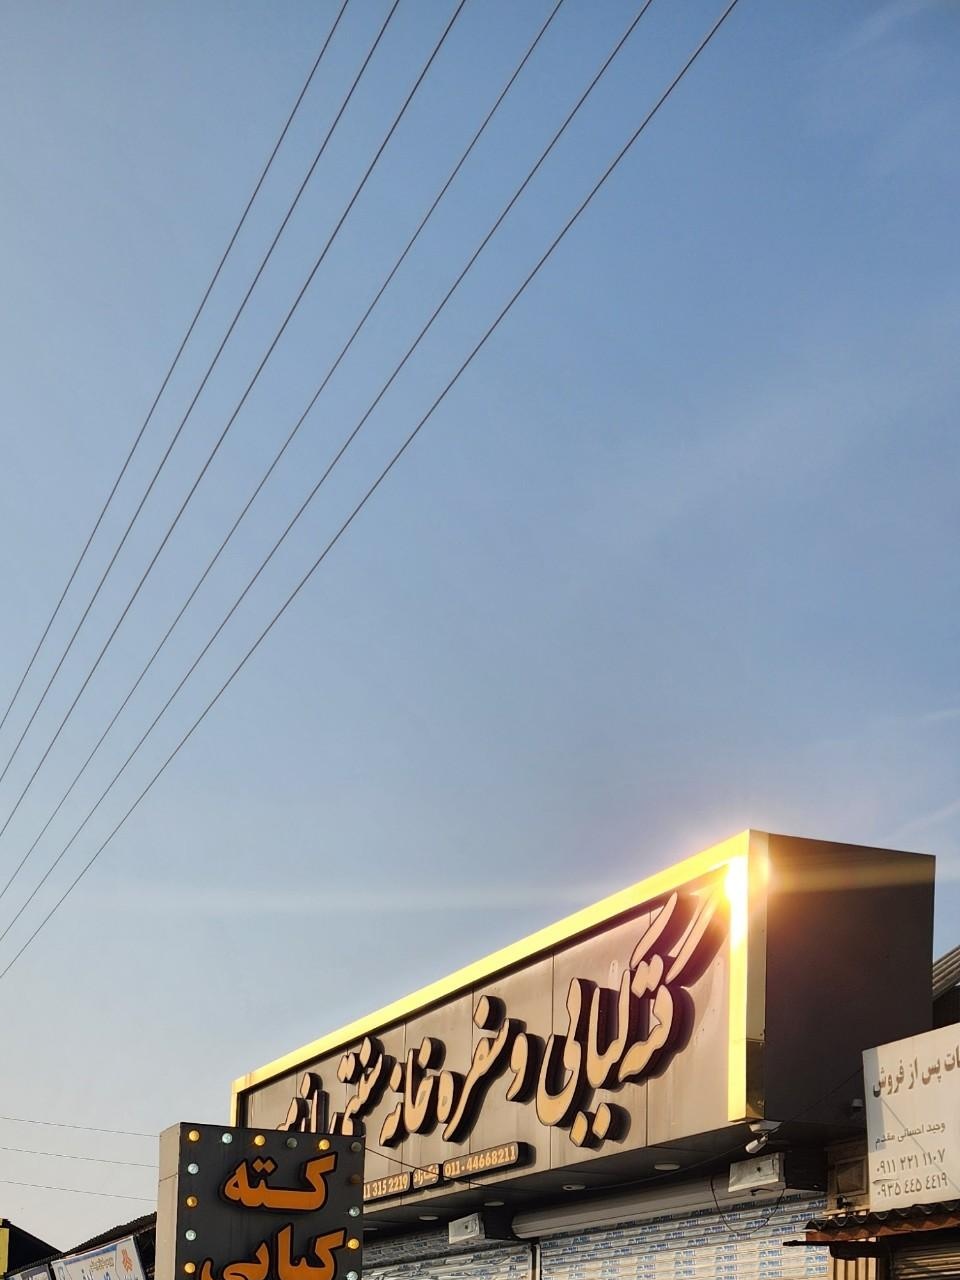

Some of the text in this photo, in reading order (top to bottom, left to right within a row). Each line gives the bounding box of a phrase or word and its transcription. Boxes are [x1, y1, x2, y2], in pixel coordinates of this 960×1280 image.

[619, 886, 722, 1084] کته
[536, 890, 678, 1147] کبابی
[378, 1035, 434, 1148] خانه
[436, 994, 510, 1143] سفره
[506, 1031, 529, 1102] و
[872, 1059, 905, 1098] فروش
[908, 1056, 918, 1090] از
[921, 1058, 941, 1086] پس
[223, 1153, 338, 1212] کته
[372, 1180, 387, 1196] 315
[876, 1160, 896, 1174] ۰۹۱۱
[923, 1148, 946, 1166] ۱۱۰۷
